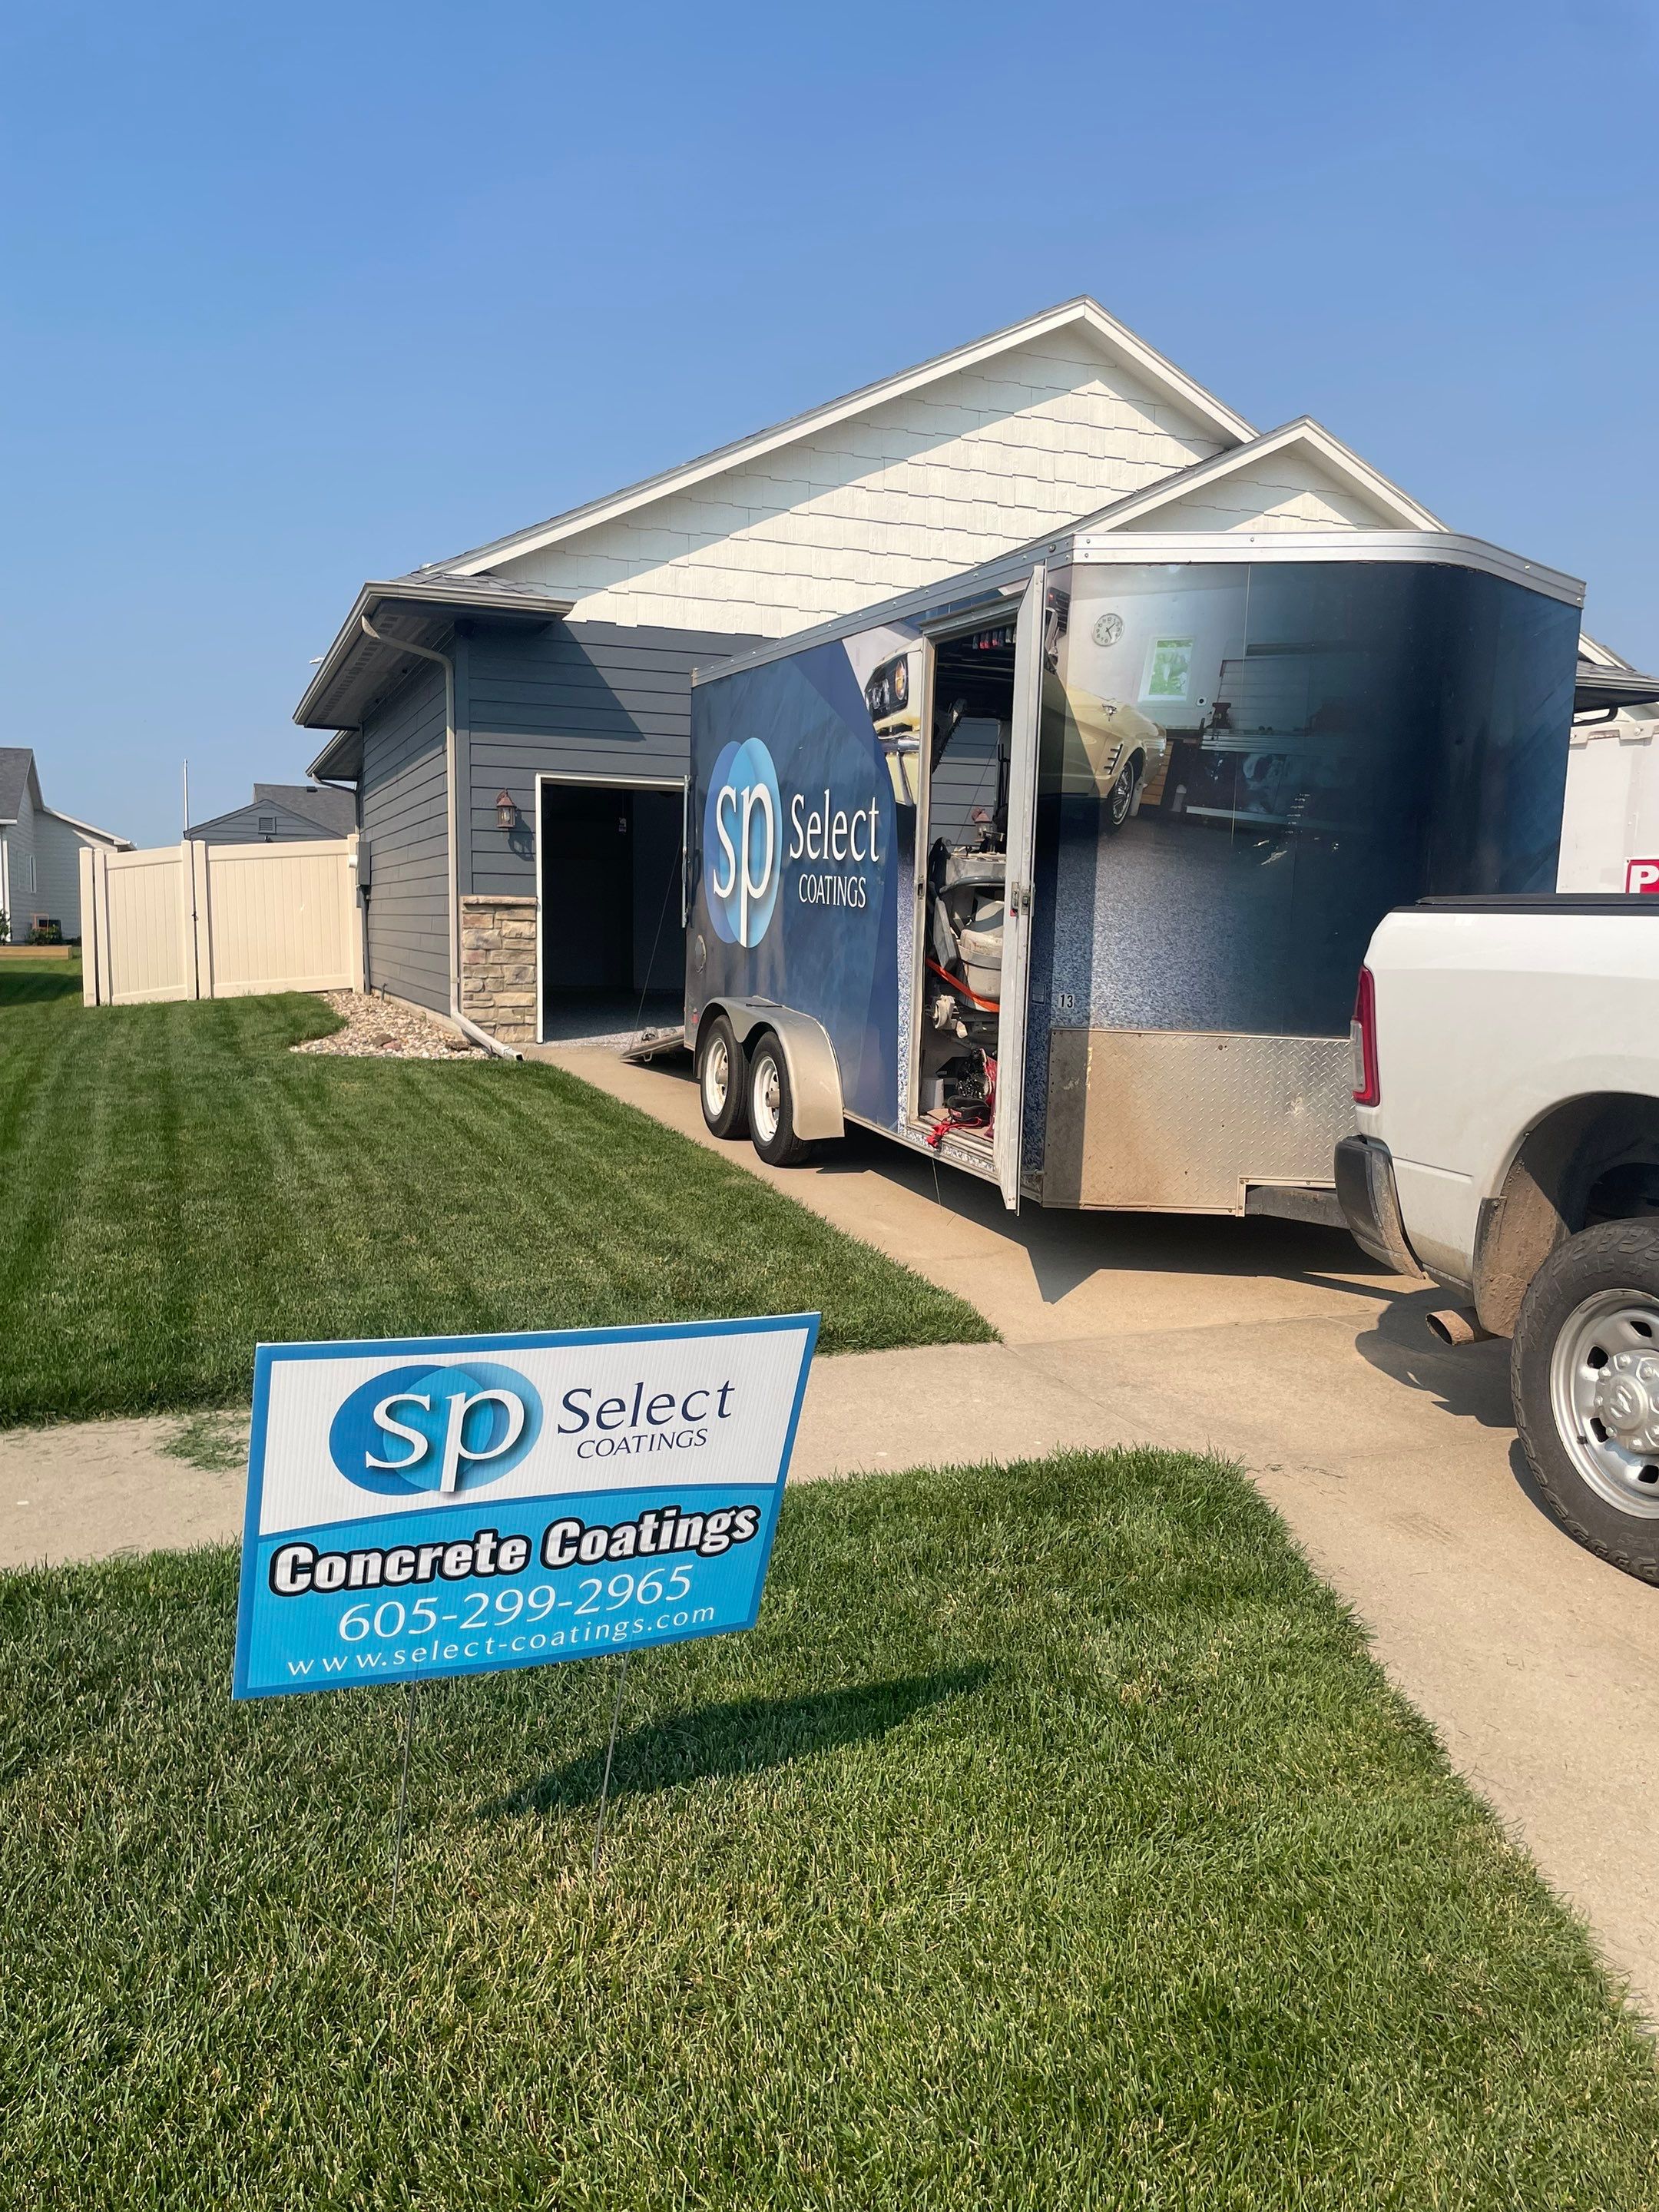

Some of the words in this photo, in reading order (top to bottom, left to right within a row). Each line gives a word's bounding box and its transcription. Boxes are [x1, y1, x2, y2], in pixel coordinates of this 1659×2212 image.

[790, 789, 879, 863] Select
[714, 783, 773, 947] sp
[799, 873, 866, 908] COATINGS
[1060, 994, 1074, 1008] 13
[365, 1389, 525, 1492] sp
[557, 1380, 735, 1434] Select
[577, 1429, 707, 1459] COATINGS
[269, 1528, 530, 1596] Concrete
[540, 1505, 760, 1568] Coatings
[339, 1565, 693, 1641] 605-299-2965
[287, 1606, 715, 1676] www.select-coatings.com
